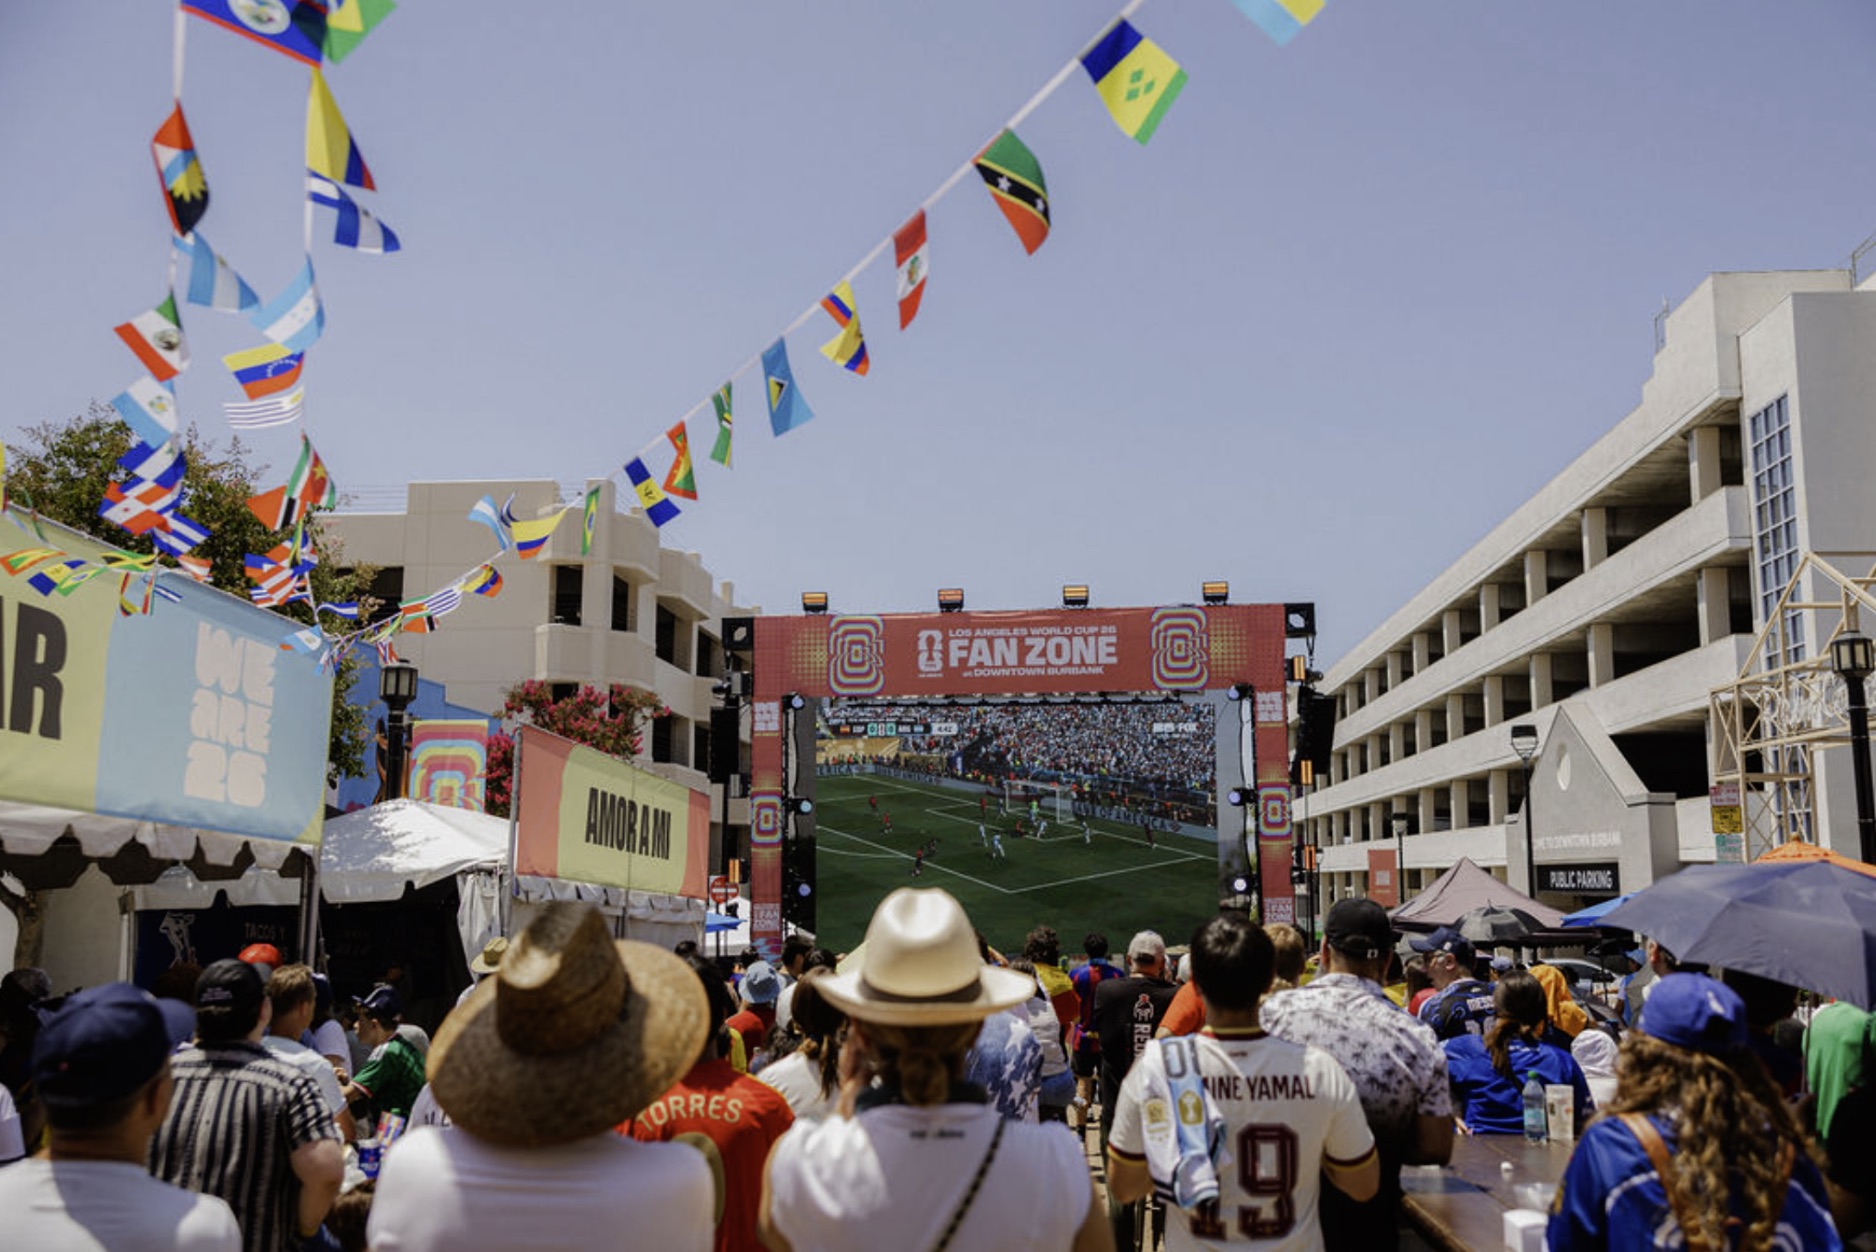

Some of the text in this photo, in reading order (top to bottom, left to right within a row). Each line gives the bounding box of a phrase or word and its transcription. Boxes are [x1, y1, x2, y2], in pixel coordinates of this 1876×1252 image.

[949, 628, 972, 637] LOS
[974, 627, 1028, 637] ANGELES
[1030, 626, 1073, 636] WORLD
[1074, 625, 1099, 635] CUP
[0, 595, 67, 740] R
[195, 620, 278, 708] WE
[949, 635, 1118, 667] FAN ZONE
[974, 667, 1047, 678] DOWNTOWN
[1047, 665, 1105, 676] BURBANK
[189, 687, 273, 754] ARE
[585, 786, 637, 854] AMOR
[651, 807, 671, 860] MI
[1549, 869, 1613, 889] PUBLIC PARKING
[1246, 1074, 1316, 1101] YAMAL
[635, 1093, 743, 1132] TORRES
